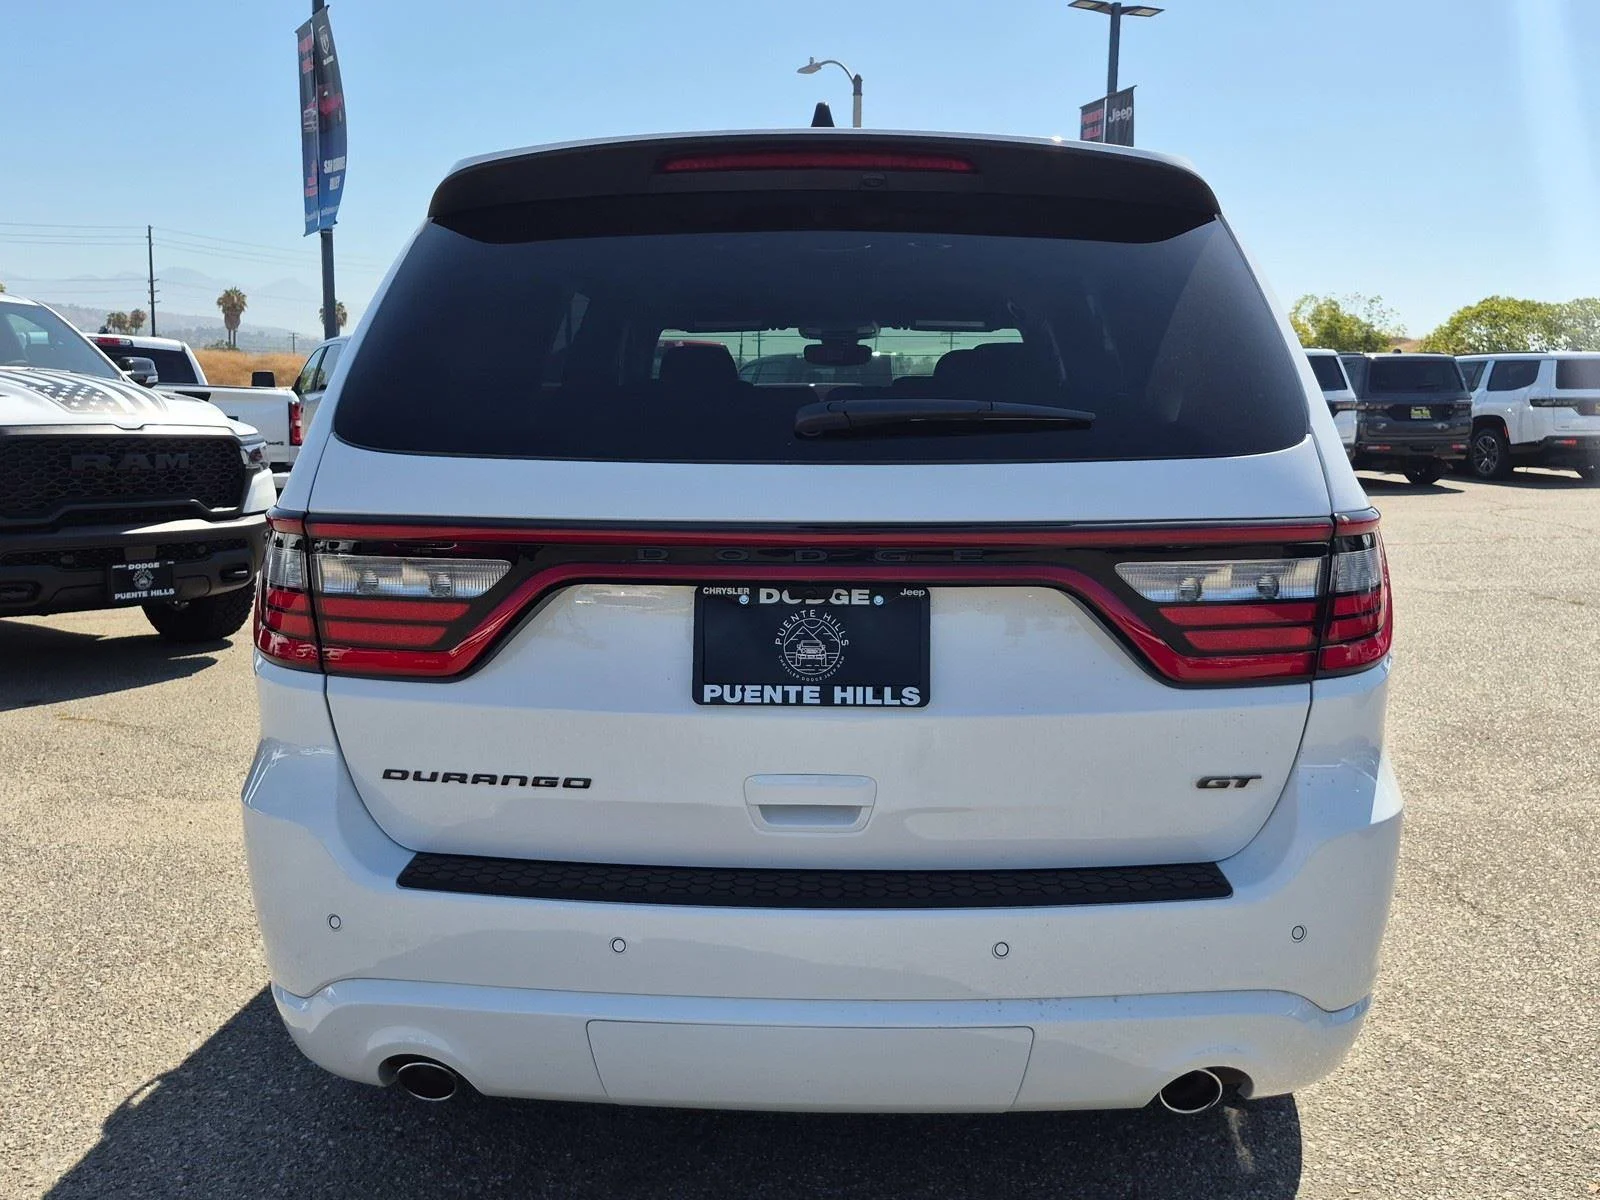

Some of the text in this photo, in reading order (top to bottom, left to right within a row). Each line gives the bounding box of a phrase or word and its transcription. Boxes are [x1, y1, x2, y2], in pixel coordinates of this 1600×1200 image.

[1108, 107, 1132, 122] Jeep
[71, 453, 189, 470] RAM
[637, 549, 985, 562] DODGE
[128, 562, 160, 570] DODGE
[114, 588, 175, 600] PUENTE HILLS
[703, 587, 750, 595] CHRYSLER
[759, 588, 870, 605] DGE
[900, 588, 926, 597] Jeep
[775, 609, 850, 646] PUENTE HILLS
[703, 684, 921, 705] PUENTE HILLS
[382, 768, 592, 789] DURANGO
[1196, 775, 1262, 789] GT
